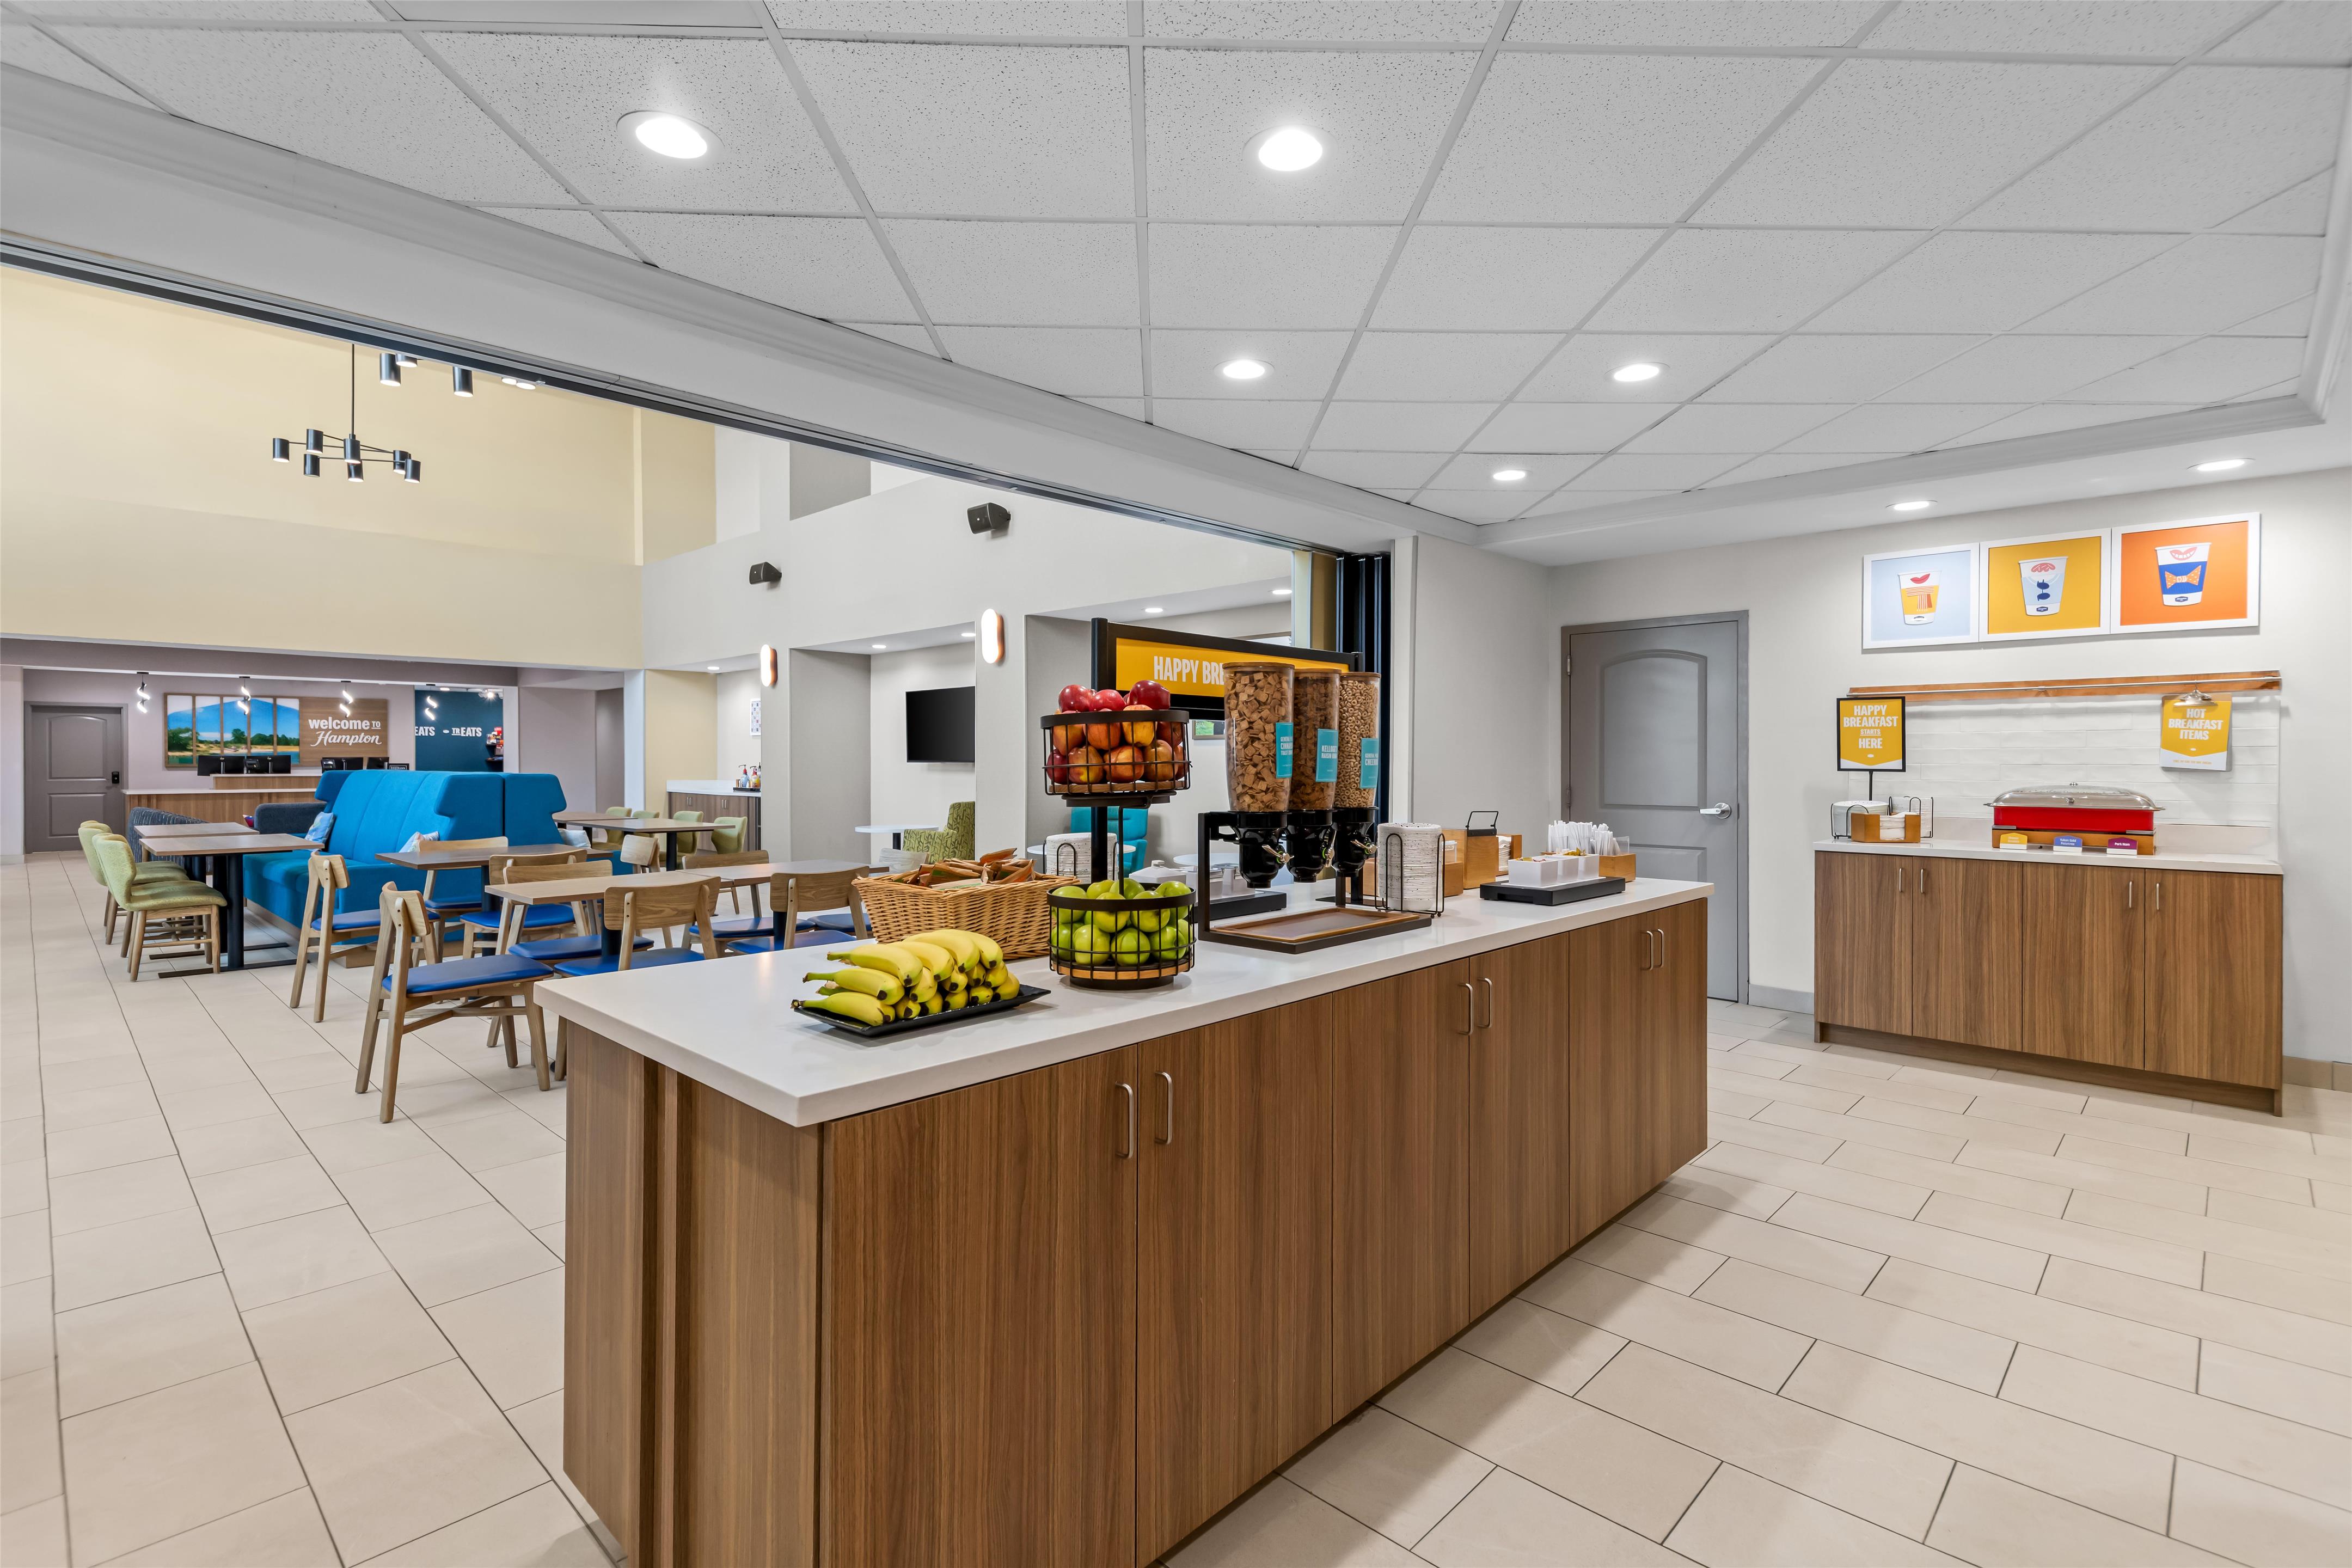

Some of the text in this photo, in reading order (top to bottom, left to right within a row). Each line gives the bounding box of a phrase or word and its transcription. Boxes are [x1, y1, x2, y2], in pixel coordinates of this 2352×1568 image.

[1154, 656, 1199, 683] HAPPY
[1854, 705, 1887, 715] HAPPY
[2186, 708, 2207, 718] HOT
[308, 716, 370, 730] welcome
[1843, 716, 1898, 727] BREAKFAST
[2169, 718, 2224, 730] BREAKFAST
[451, 727, 482, 737] TREATS
[2179, 730, 2209, 740] ITEMS
[310, 730, 382, 747] Hampton
[1858, 738, 1883, 749] HERE
